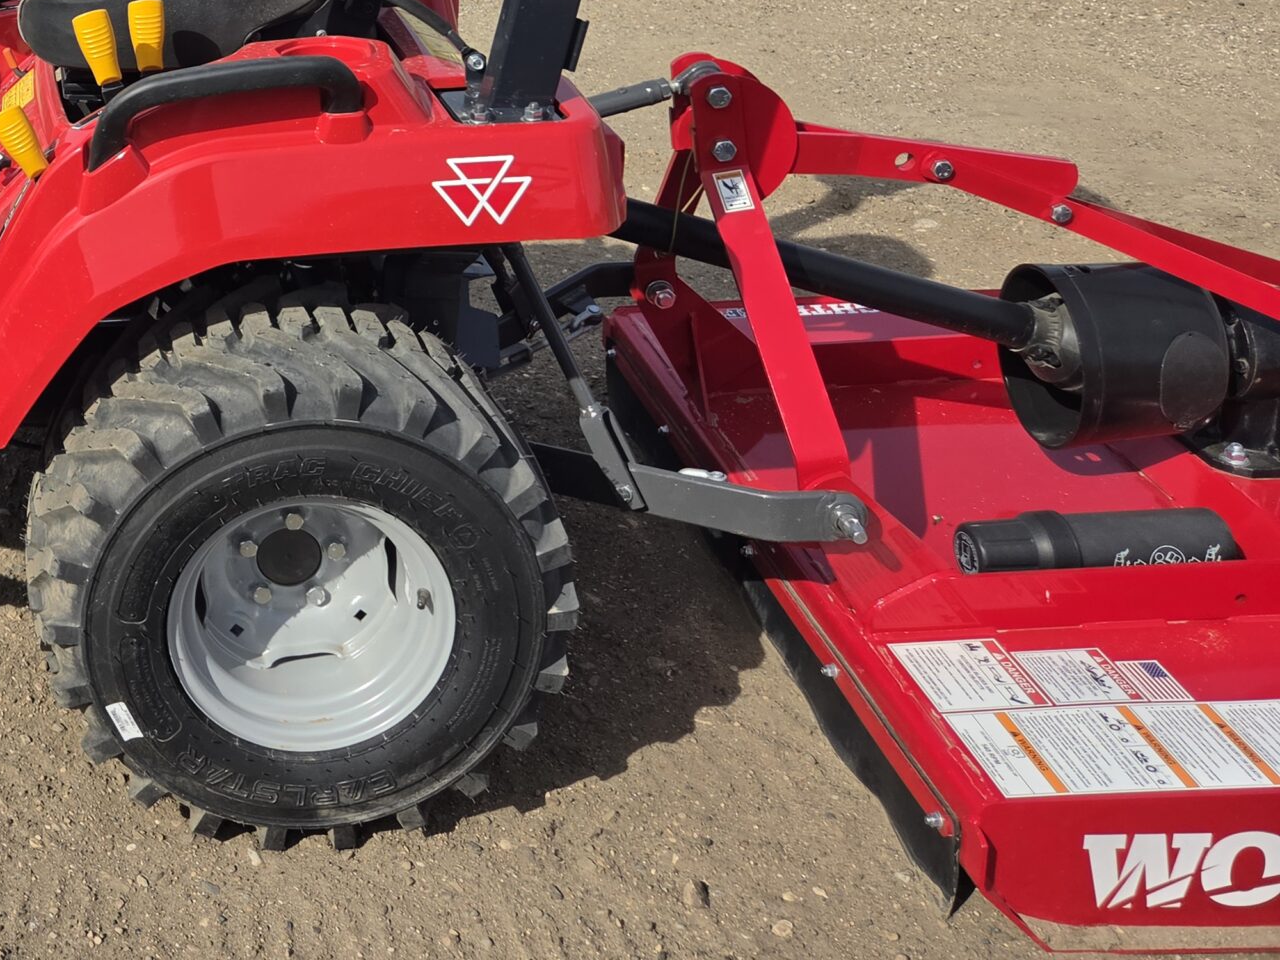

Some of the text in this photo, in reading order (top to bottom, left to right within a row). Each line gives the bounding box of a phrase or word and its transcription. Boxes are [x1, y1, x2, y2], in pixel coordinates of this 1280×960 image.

[223, 456, 465, 525] TRAC CHIEF
[1001, 658, 1036, 695] DANGER
[1101, 661, 1135, 695] DANGER
[1018, 737, 1049, 772] WARNING
[1142, 730, 1176, 765] WARNING
[177, 745, 397, 808] CARLSTAR
[1082, 830, 1280, 908] WO
